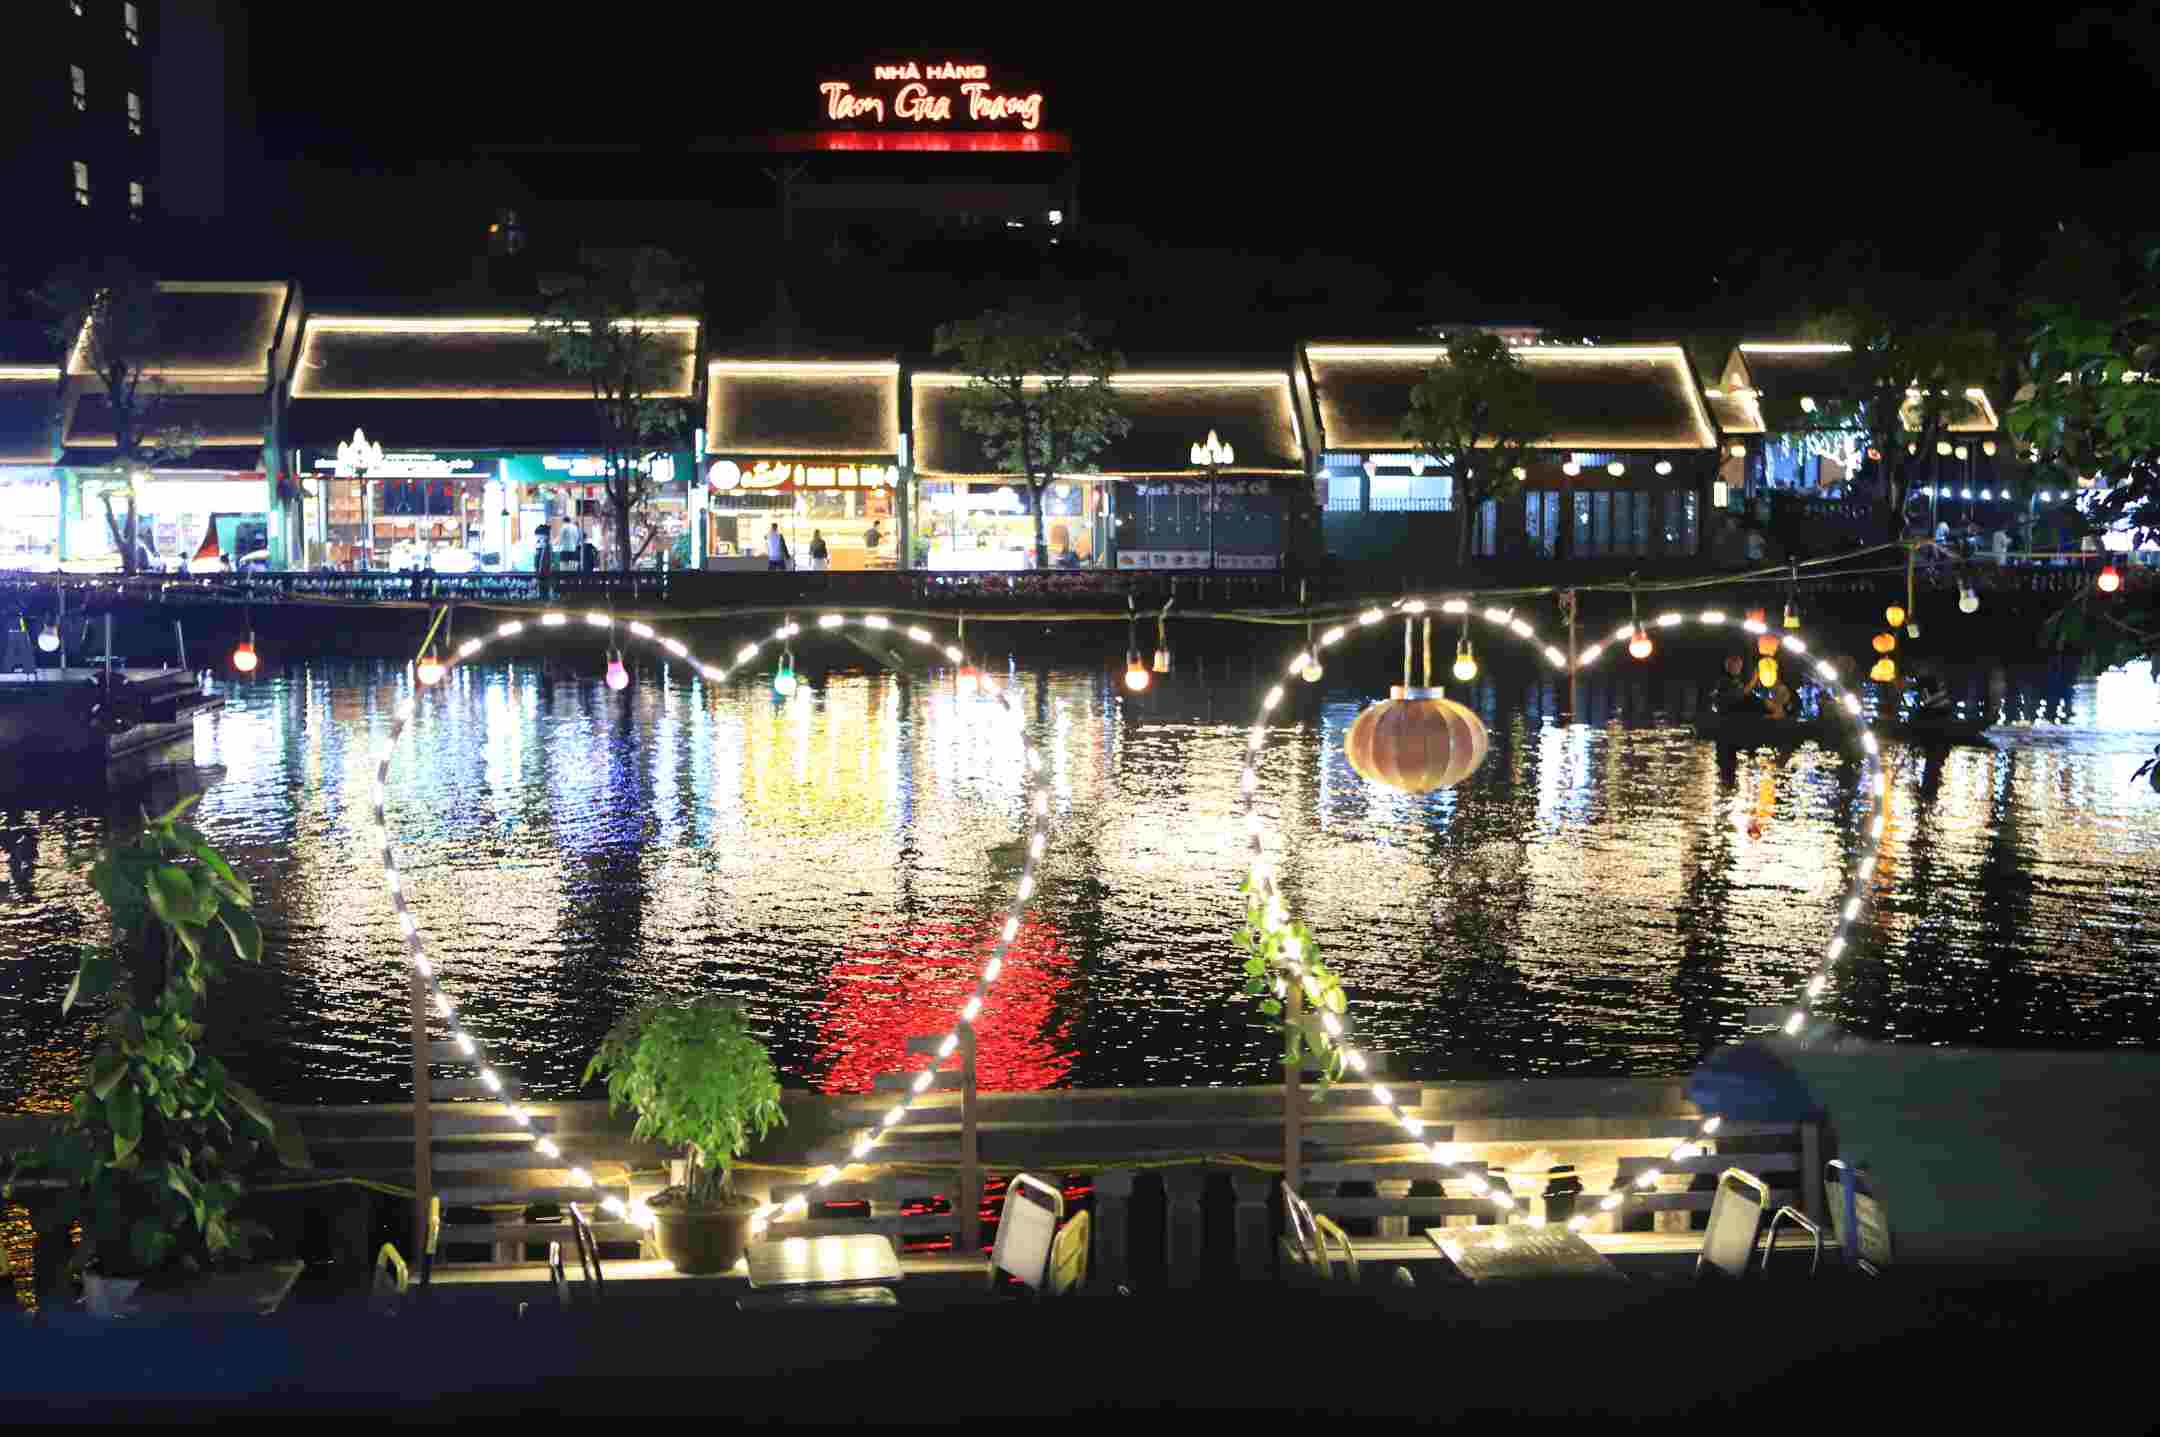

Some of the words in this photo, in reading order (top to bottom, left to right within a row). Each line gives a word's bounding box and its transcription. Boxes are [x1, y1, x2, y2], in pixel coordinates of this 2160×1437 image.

[874, 61, 921, 80] NHÀ
[926, 61, 987, 80] HÀNG
[894, 82, 951, 122] Gia
[960, 82, 1043, 130] Trang
